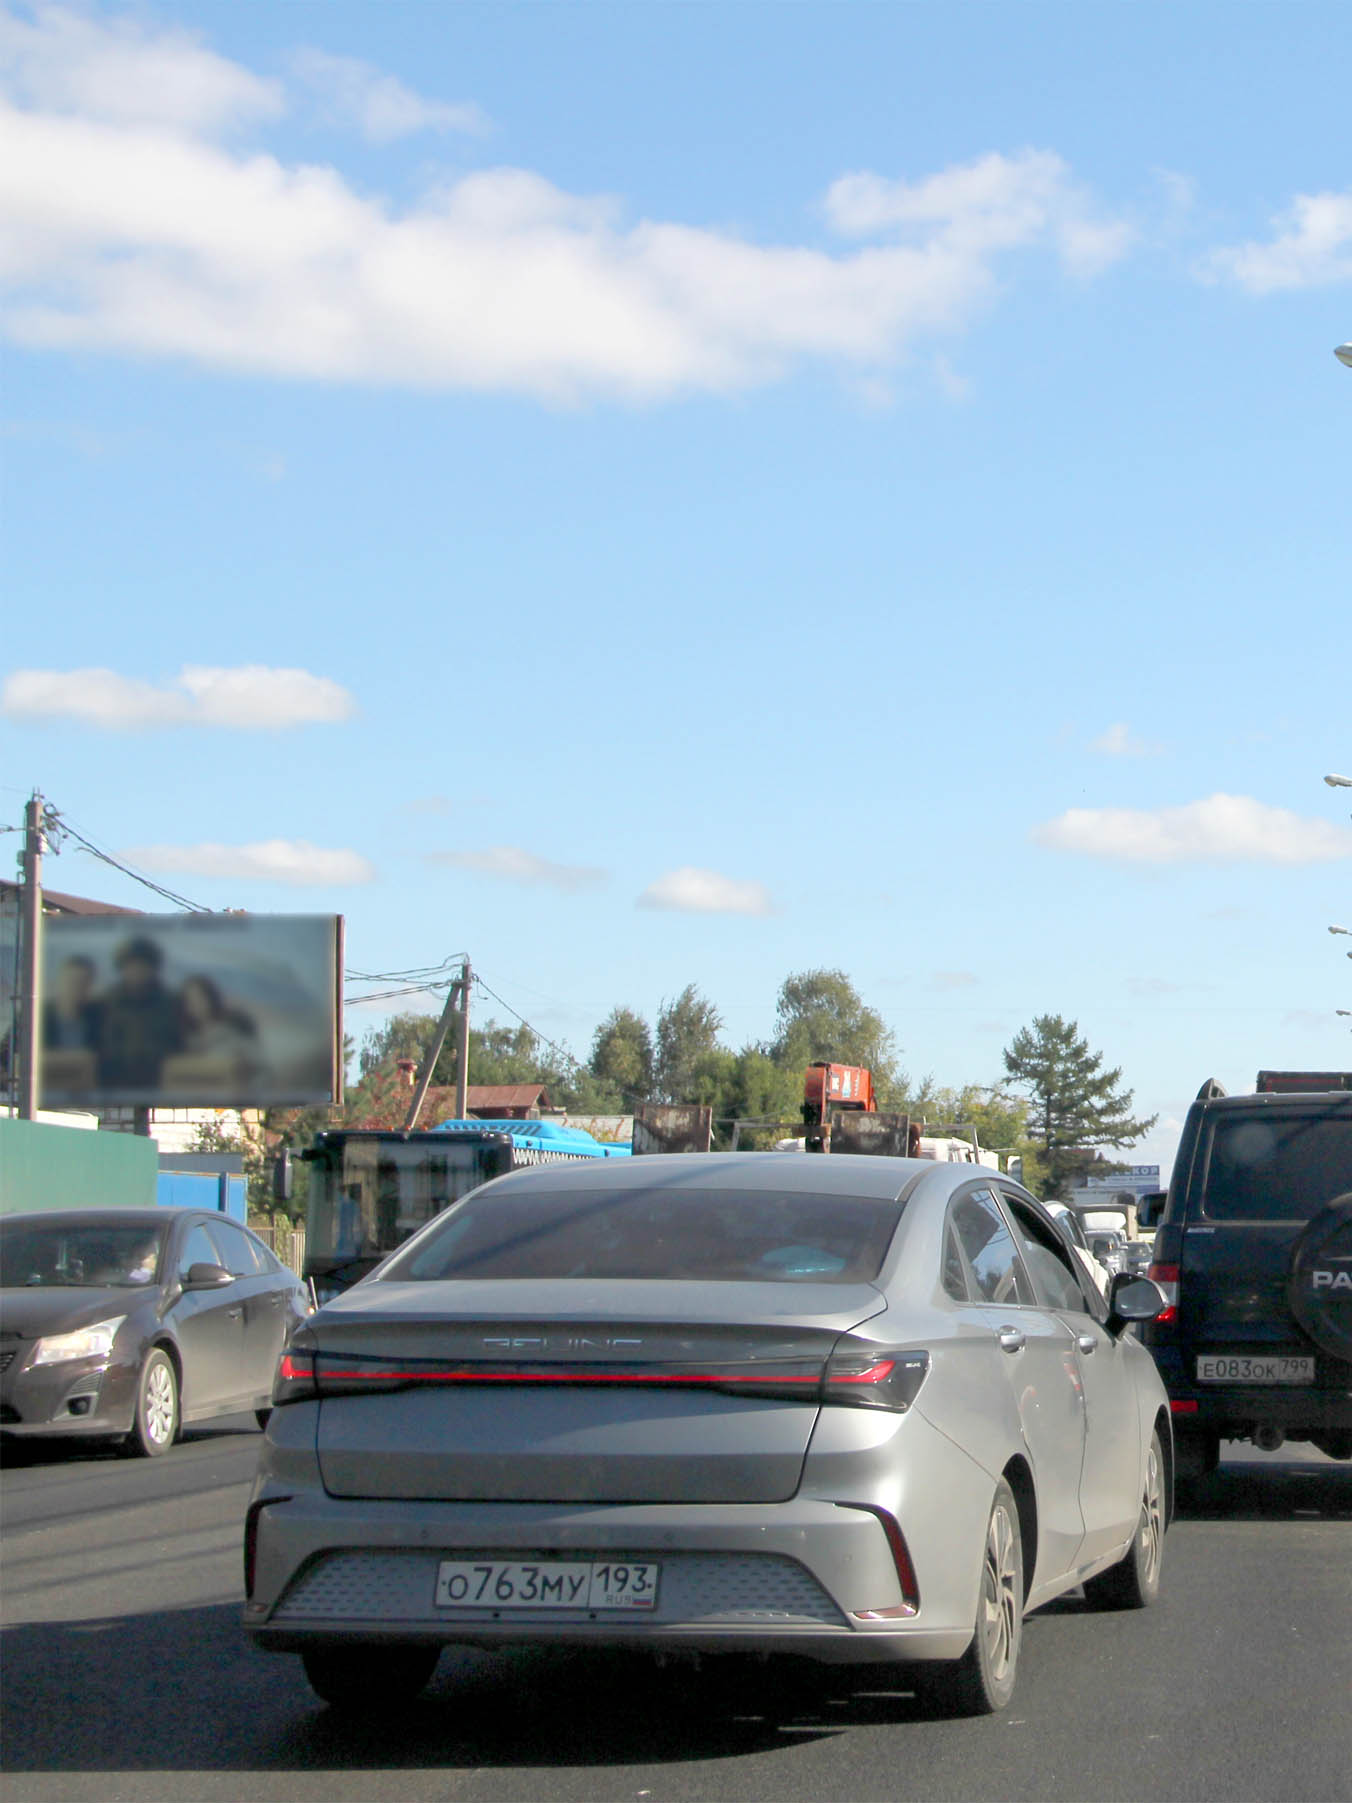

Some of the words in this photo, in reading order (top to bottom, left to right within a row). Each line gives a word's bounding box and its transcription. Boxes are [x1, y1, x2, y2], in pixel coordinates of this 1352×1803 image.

[1203, 1359, 1277, 1379] Е083ОК
[1280, 1359, 1309, 1375] 799
[448, 1566, 586, 1601] О763МУ
[595, 1566, 649, 1593] 193
